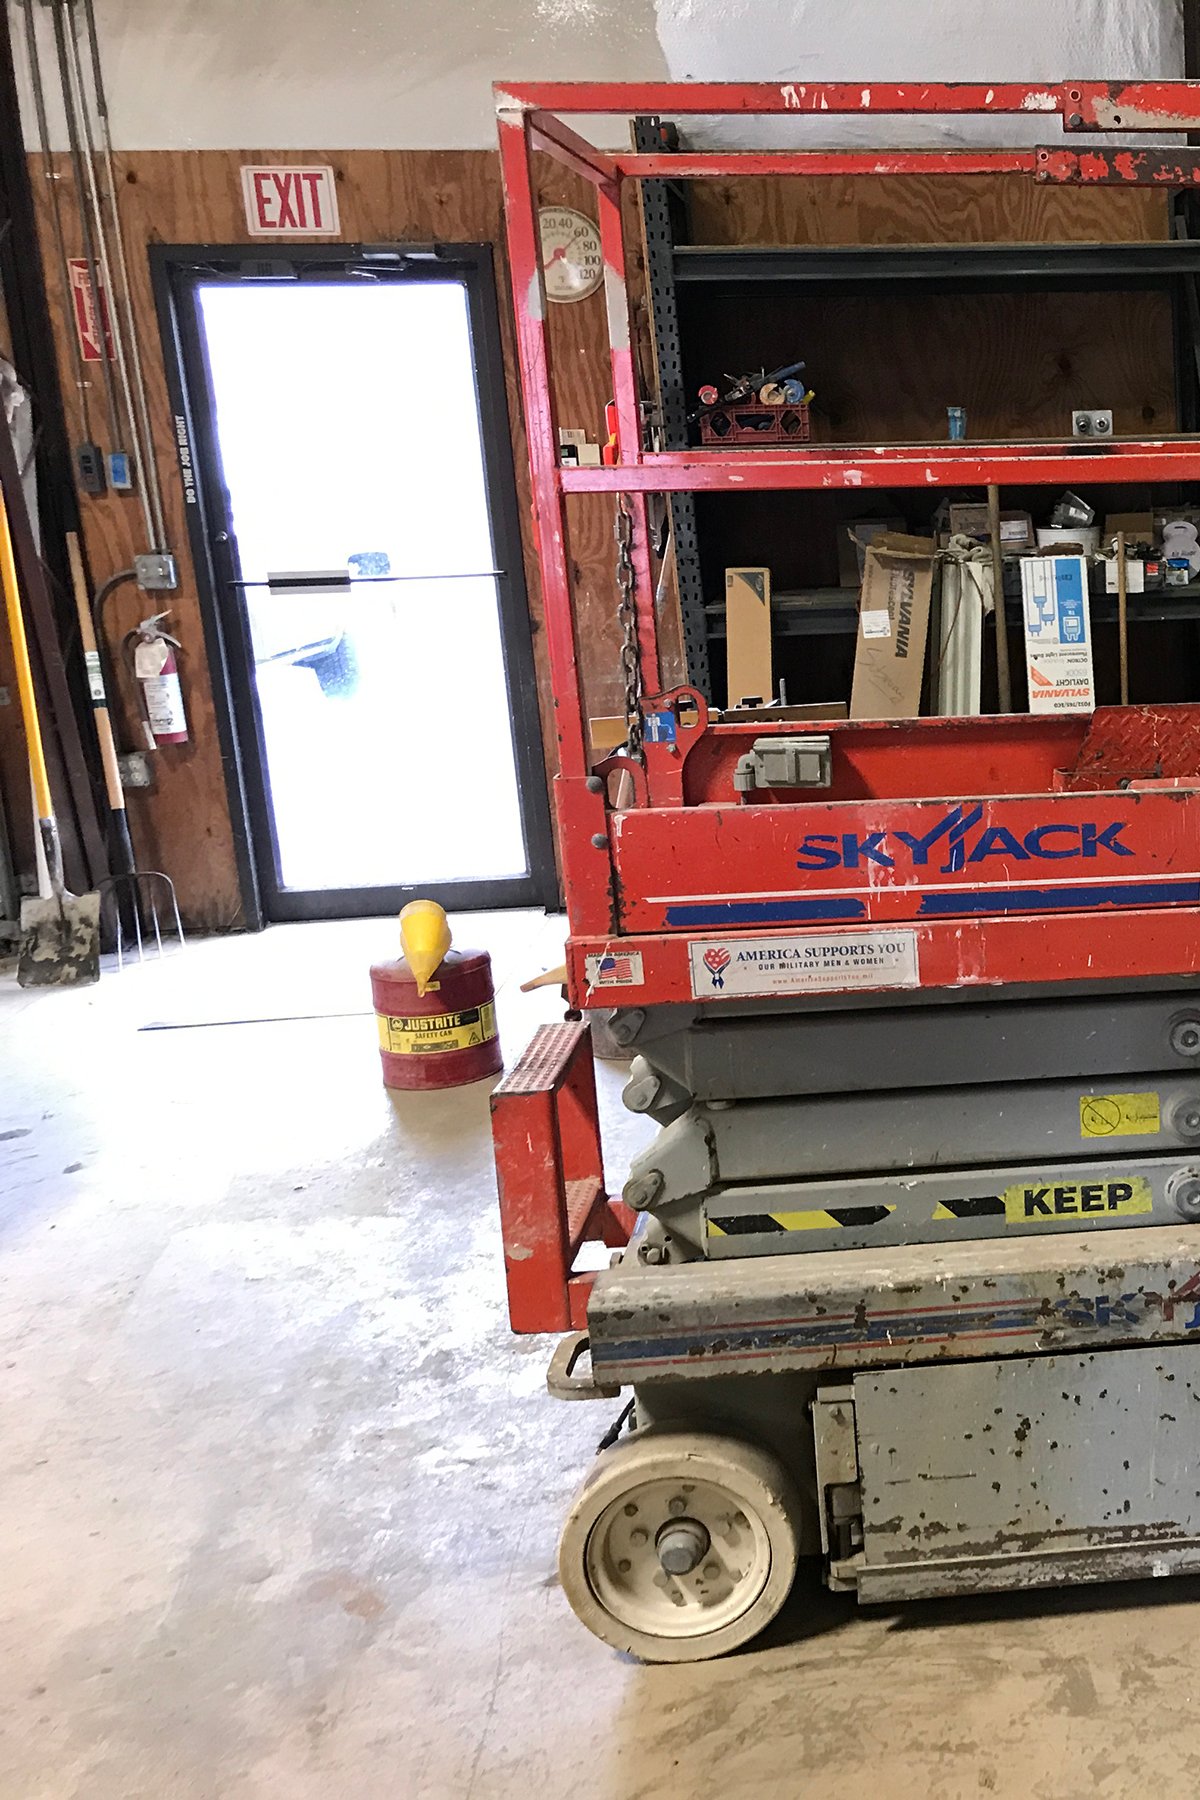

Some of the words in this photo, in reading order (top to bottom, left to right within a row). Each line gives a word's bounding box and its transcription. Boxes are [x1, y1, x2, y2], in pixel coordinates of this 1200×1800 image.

[253, 173, 323, 228] EXIT
[543, 218, 556, 229] 20
[559, 218, 573, 229] 40
[574, 227, 589, 237] 60
[583, 241, 597, 251] 80
[584, 255, 601, 266] 100
[580, 269, 596, 279] 120
[175, 414, 188, 446] RIGHT
[180, 446, 191, 467] JOB
[183, 468, 194, 487] THE
[186, 488, 196, 504] DO
[895, 569, 915, 659] SYLVANIA
[1055, 678, 1089, 687] DAYLIGHT
[1032, 688, 1090, 699] SYLVANIA
[796, 801, 1136, 874] SKYJACK
[736, 948, 801, 962] AMERICA
[804, 945, 875, 958] SUPPORTS
[878, 943, 906, 954] YOU
[779, 961, 820, 970] MILITARY
[853, 957, 885, 966] WOMEN
[404, 1015, 461, 1031] JUSTRITE
[414, 1031, 438, 1040] SAFETY
[439, 1030, 453, 1038] CAN
[1024, 1183, 1133, 1217] KEEP
